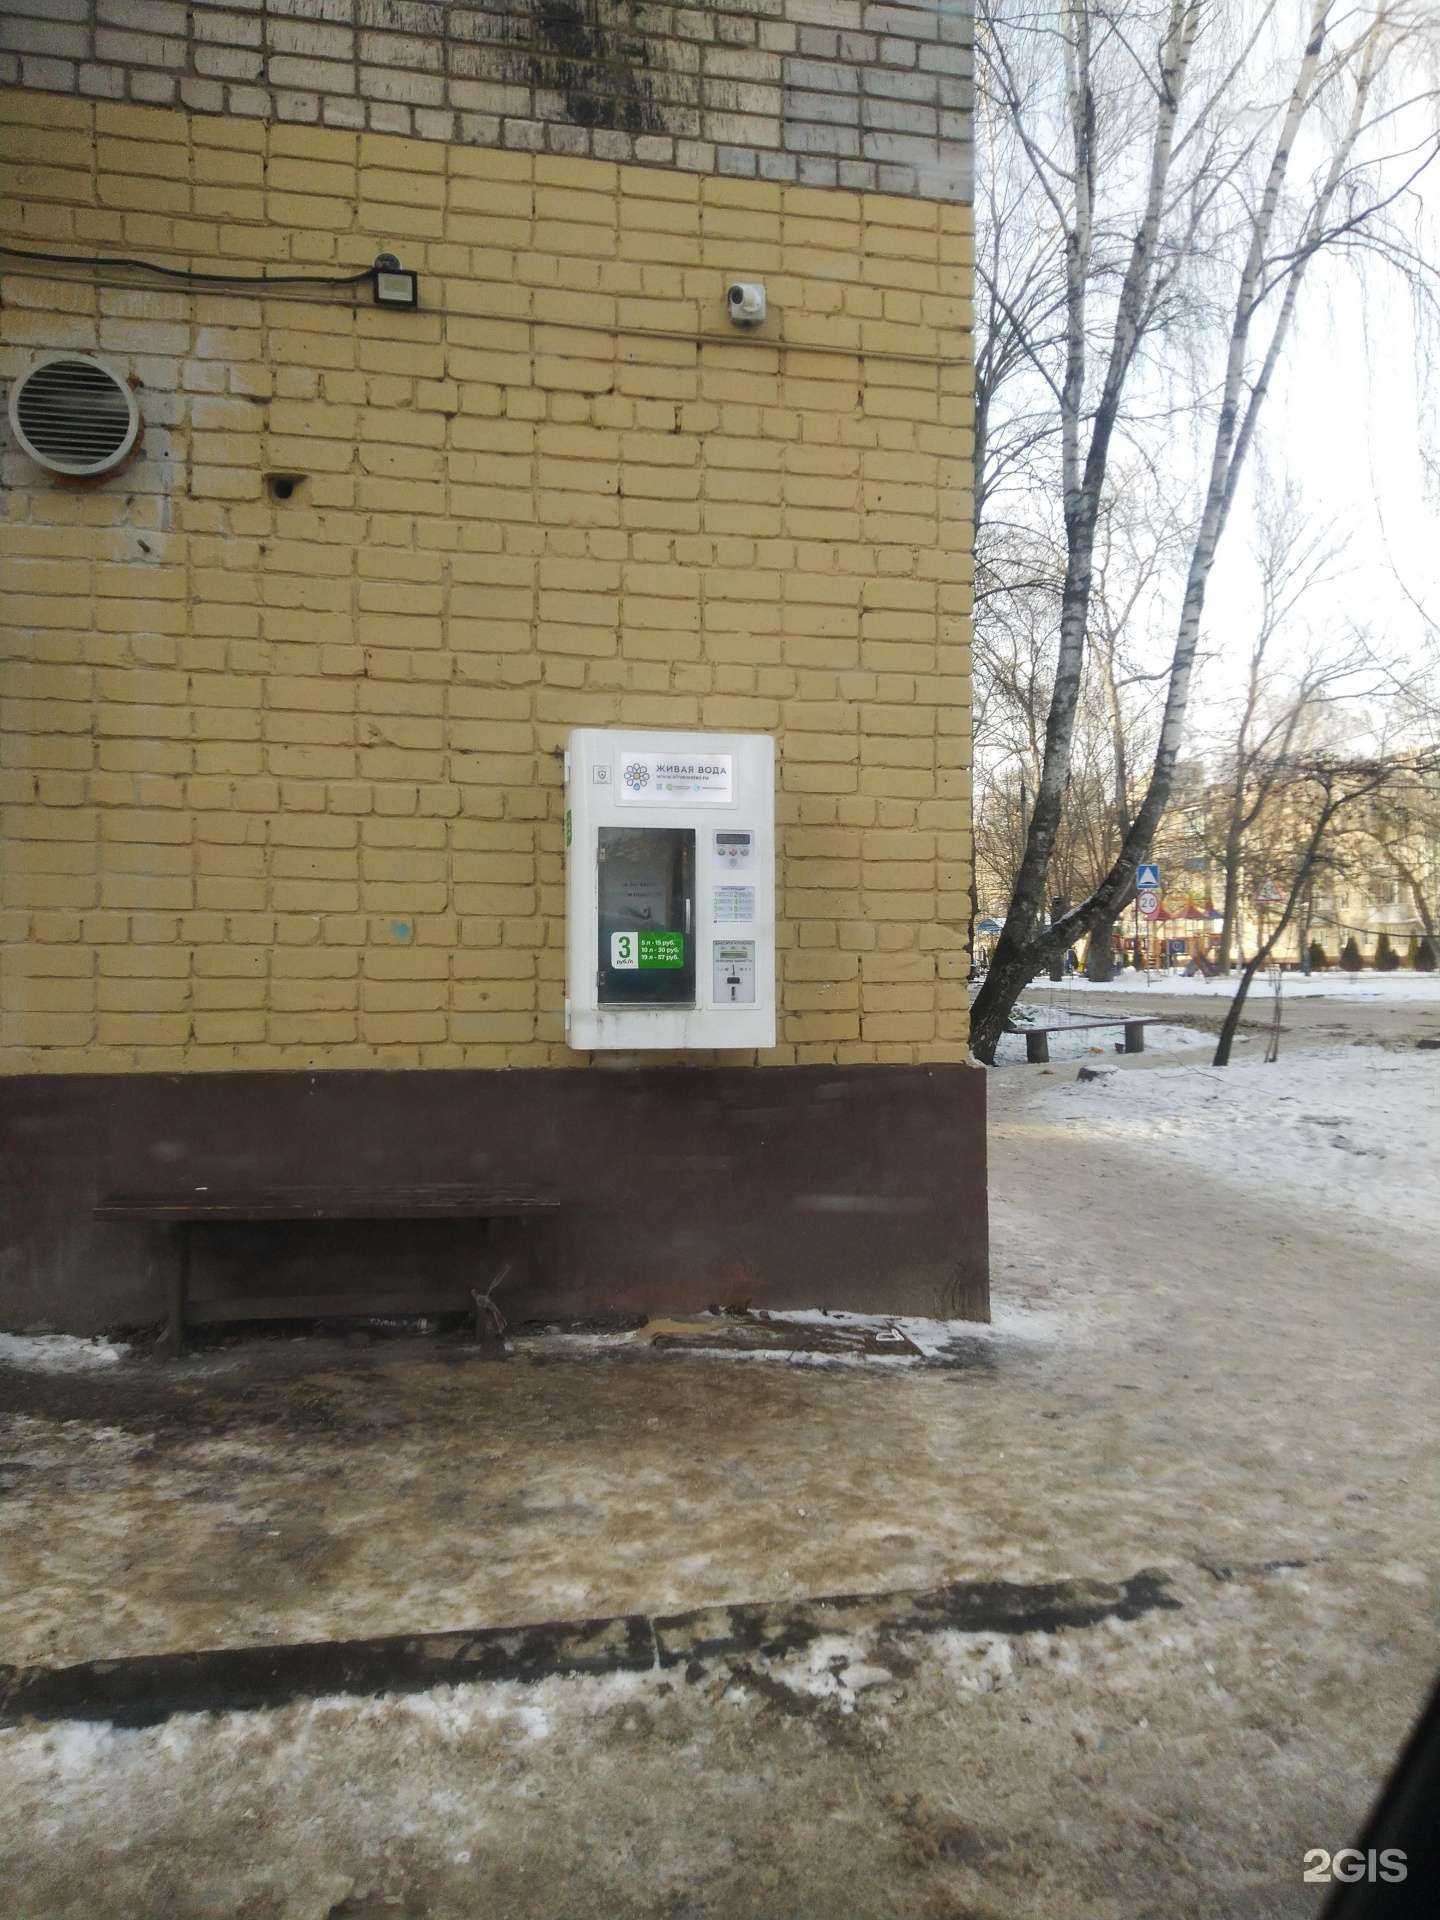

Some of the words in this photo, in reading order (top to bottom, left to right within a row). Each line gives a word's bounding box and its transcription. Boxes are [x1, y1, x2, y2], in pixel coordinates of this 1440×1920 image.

[656, 764, 694, 773] ЖИВАЯ
[698, 766, 727, 775] ВОДА
[1141, 898, 1156, 908] 20
[618, 936, 630, 958] 3
